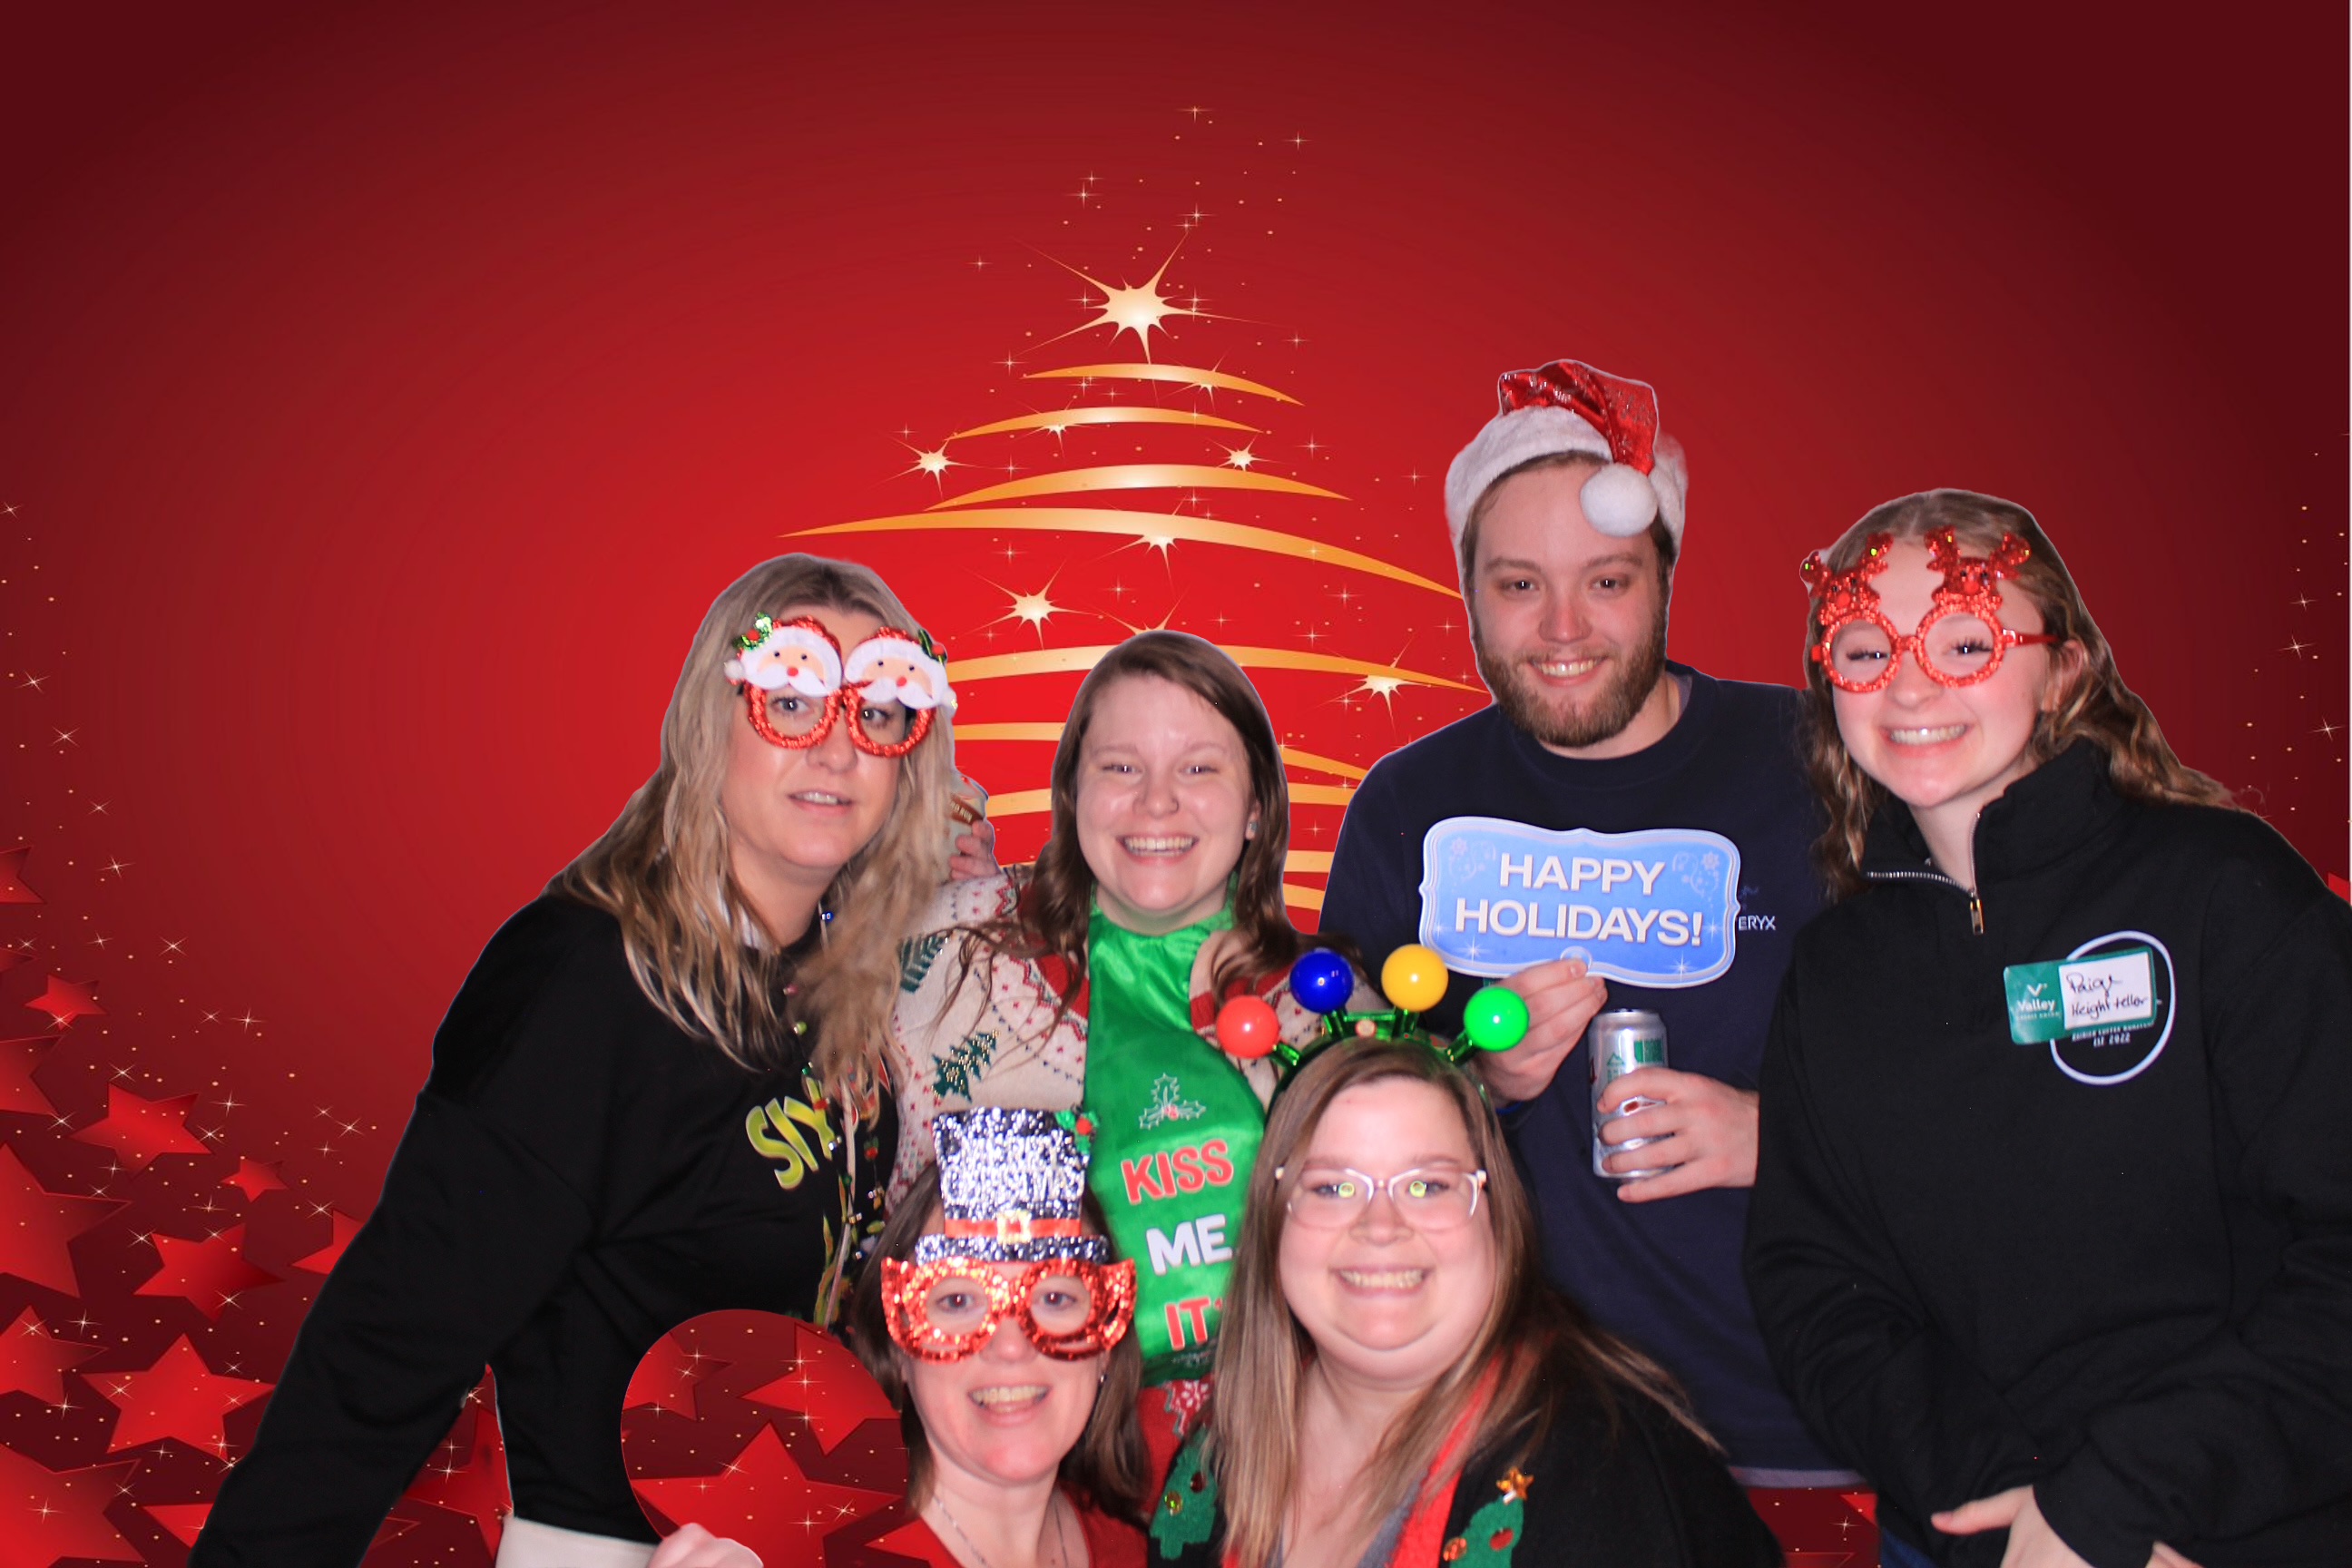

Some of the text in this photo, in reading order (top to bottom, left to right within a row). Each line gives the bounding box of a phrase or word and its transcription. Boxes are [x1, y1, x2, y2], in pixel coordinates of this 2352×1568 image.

[1499, 852, 1666, 896] HAPPY
[1455, 897, 1704, 946] HOLIDAYS!
[1738, 915, 1777, 931] ERYX
[2016, 998, 2056, 1014] Valley
[1121, 1139, 1234, 1205] KISS
[1146, 1213, 1233, 1276] ME
